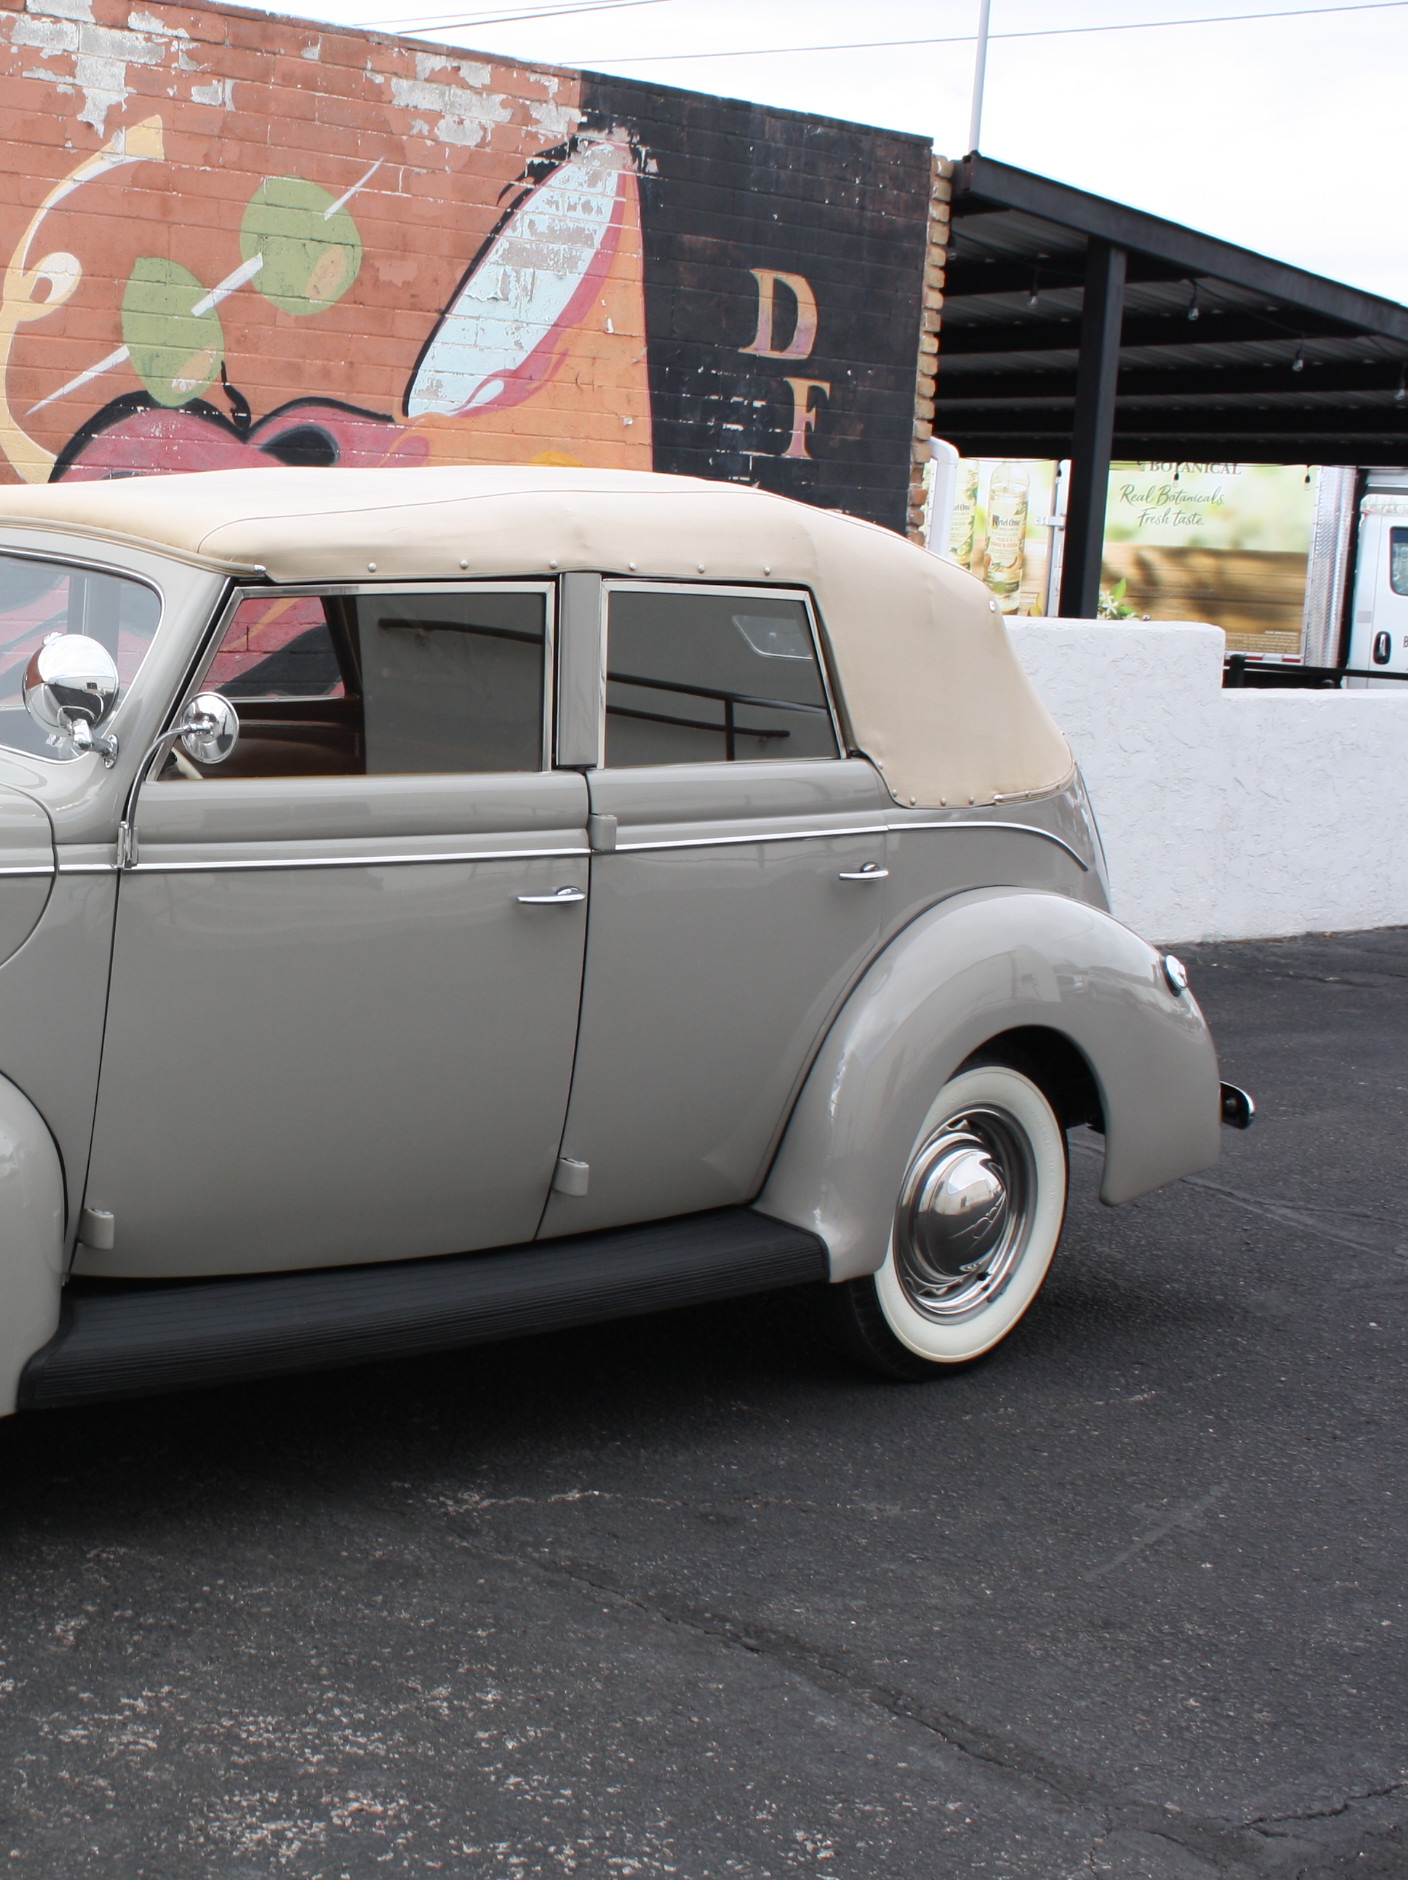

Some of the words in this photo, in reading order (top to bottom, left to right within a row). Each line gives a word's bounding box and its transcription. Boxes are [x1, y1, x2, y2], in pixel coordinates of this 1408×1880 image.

[738, 268, 818, 360] D
[781, 377, 831, 460] F
[1120, 484, 1154, 506] Real
[1137, 507, 1169, 528] Fresh
